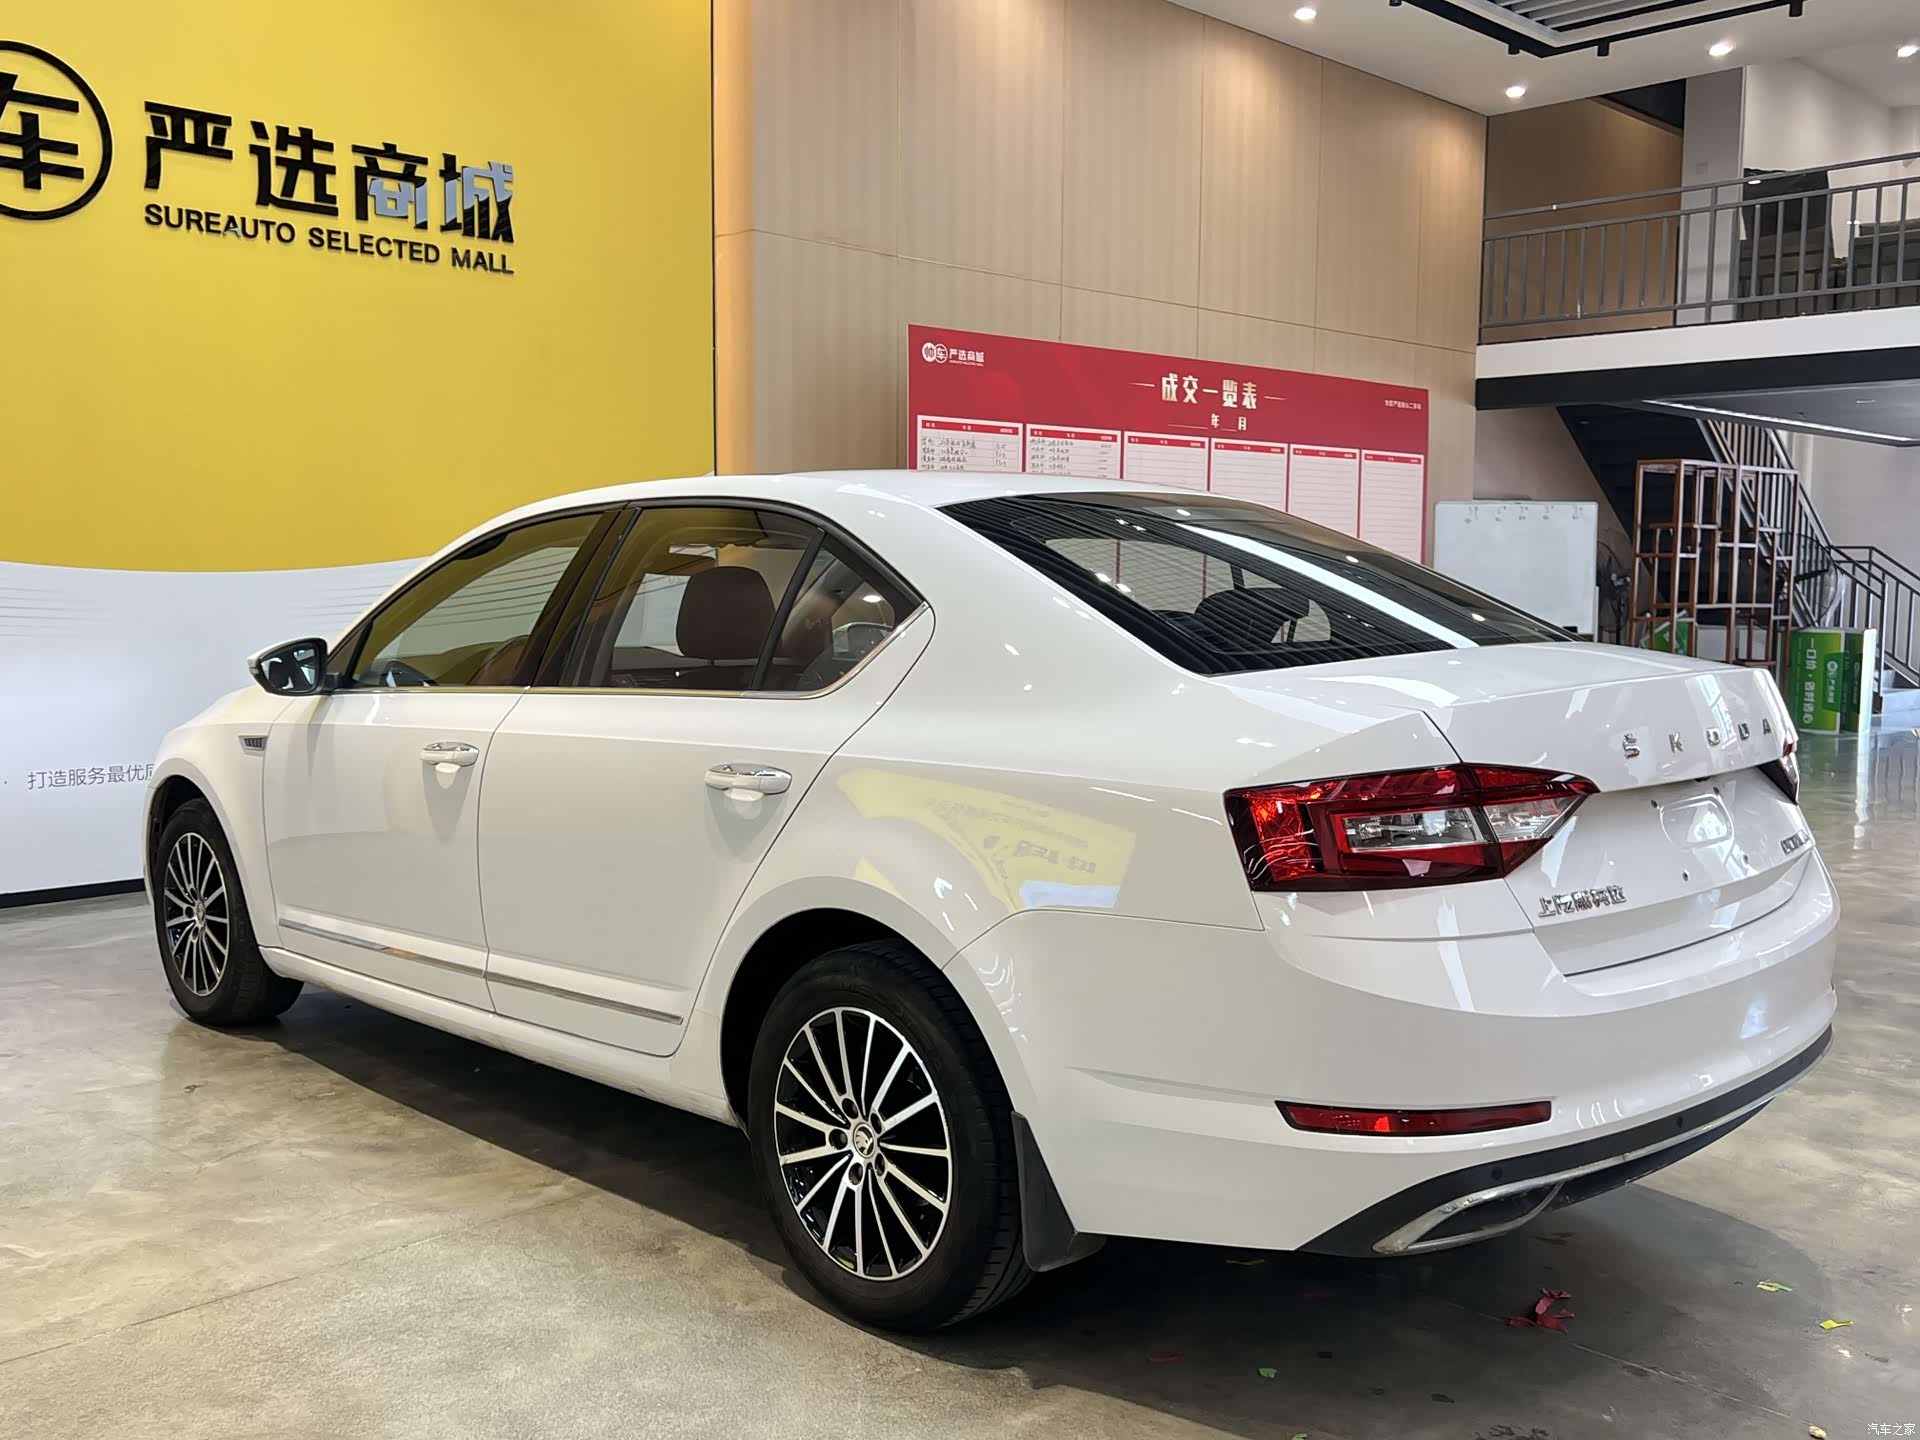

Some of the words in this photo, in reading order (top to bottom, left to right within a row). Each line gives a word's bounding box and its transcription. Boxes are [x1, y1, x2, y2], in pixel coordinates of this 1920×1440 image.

[145, 101, 514, 243] 严选商城
[145, 203, 296, 244] SUREAUTO
[308, 226, 439, 264] SELECTED
[451, 246, 514, 274] MALL
[1161, 372, 1257, 409] 成交一览表
[1211, 413, 1220, 428] 年
[1238, 416, 1247, 431] 月
